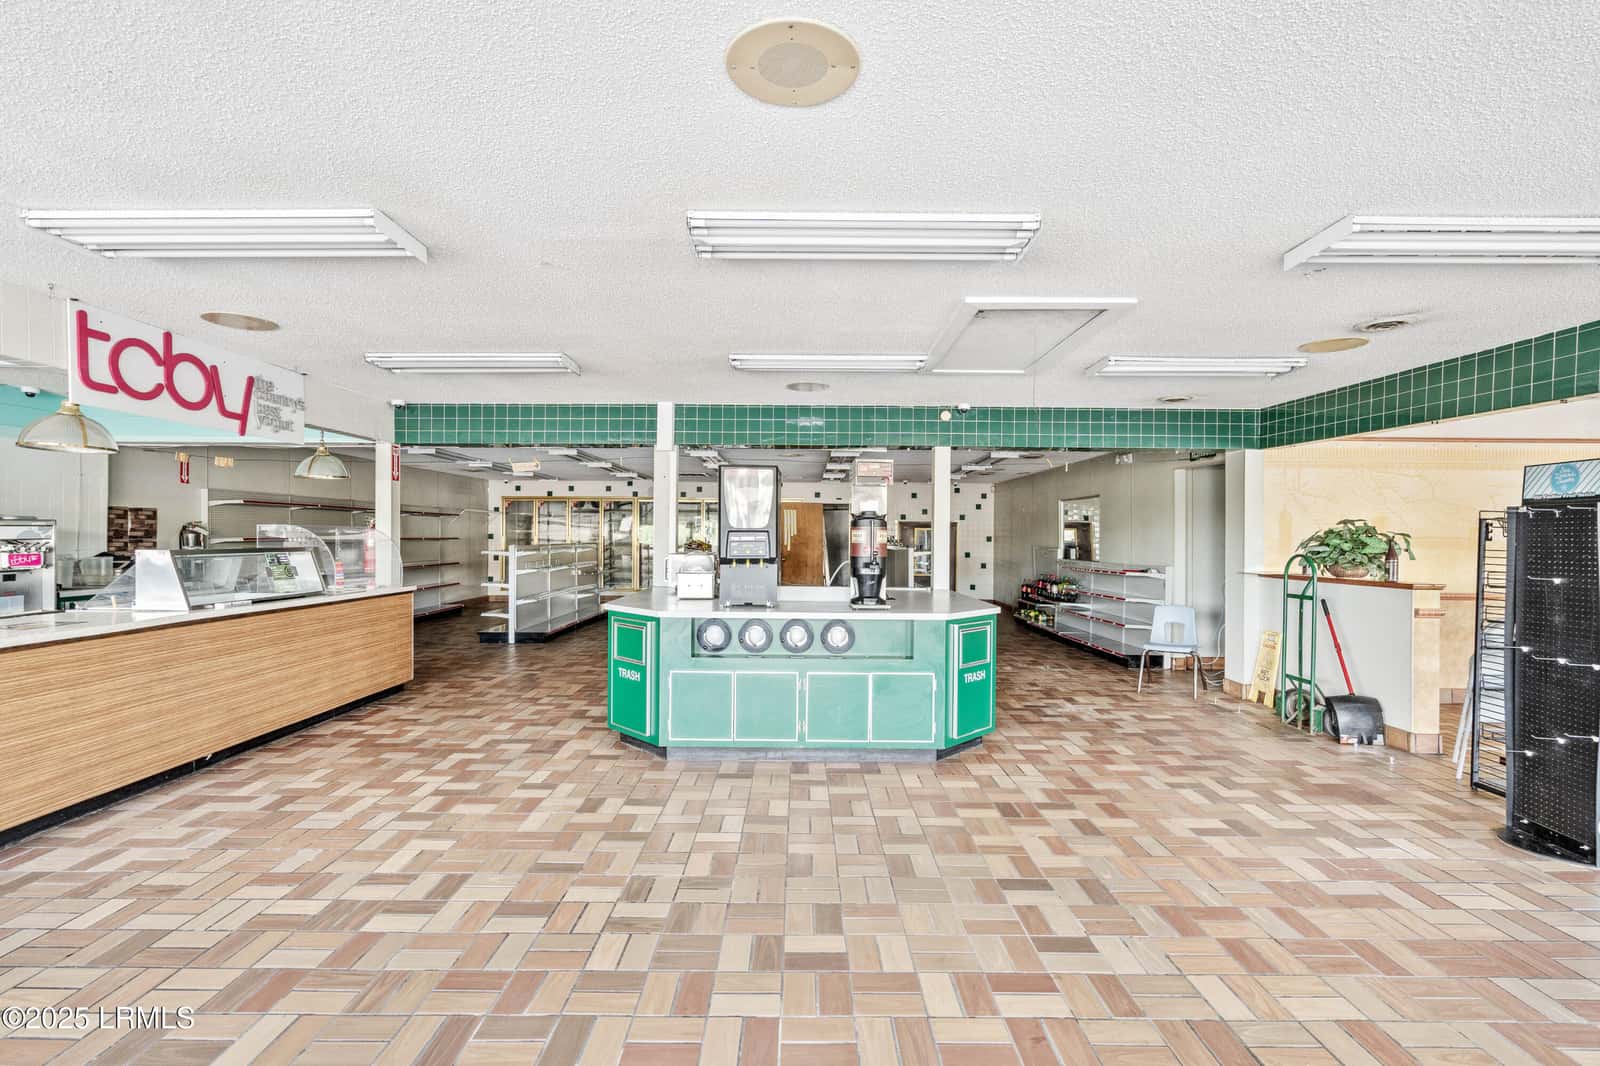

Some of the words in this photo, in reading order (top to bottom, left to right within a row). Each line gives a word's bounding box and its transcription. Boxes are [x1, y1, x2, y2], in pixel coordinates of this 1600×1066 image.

[76, 310, 255, 437] tcby
[618, 667, 641, 682] TRASH
[963, 669, 986, 684] TRASH
